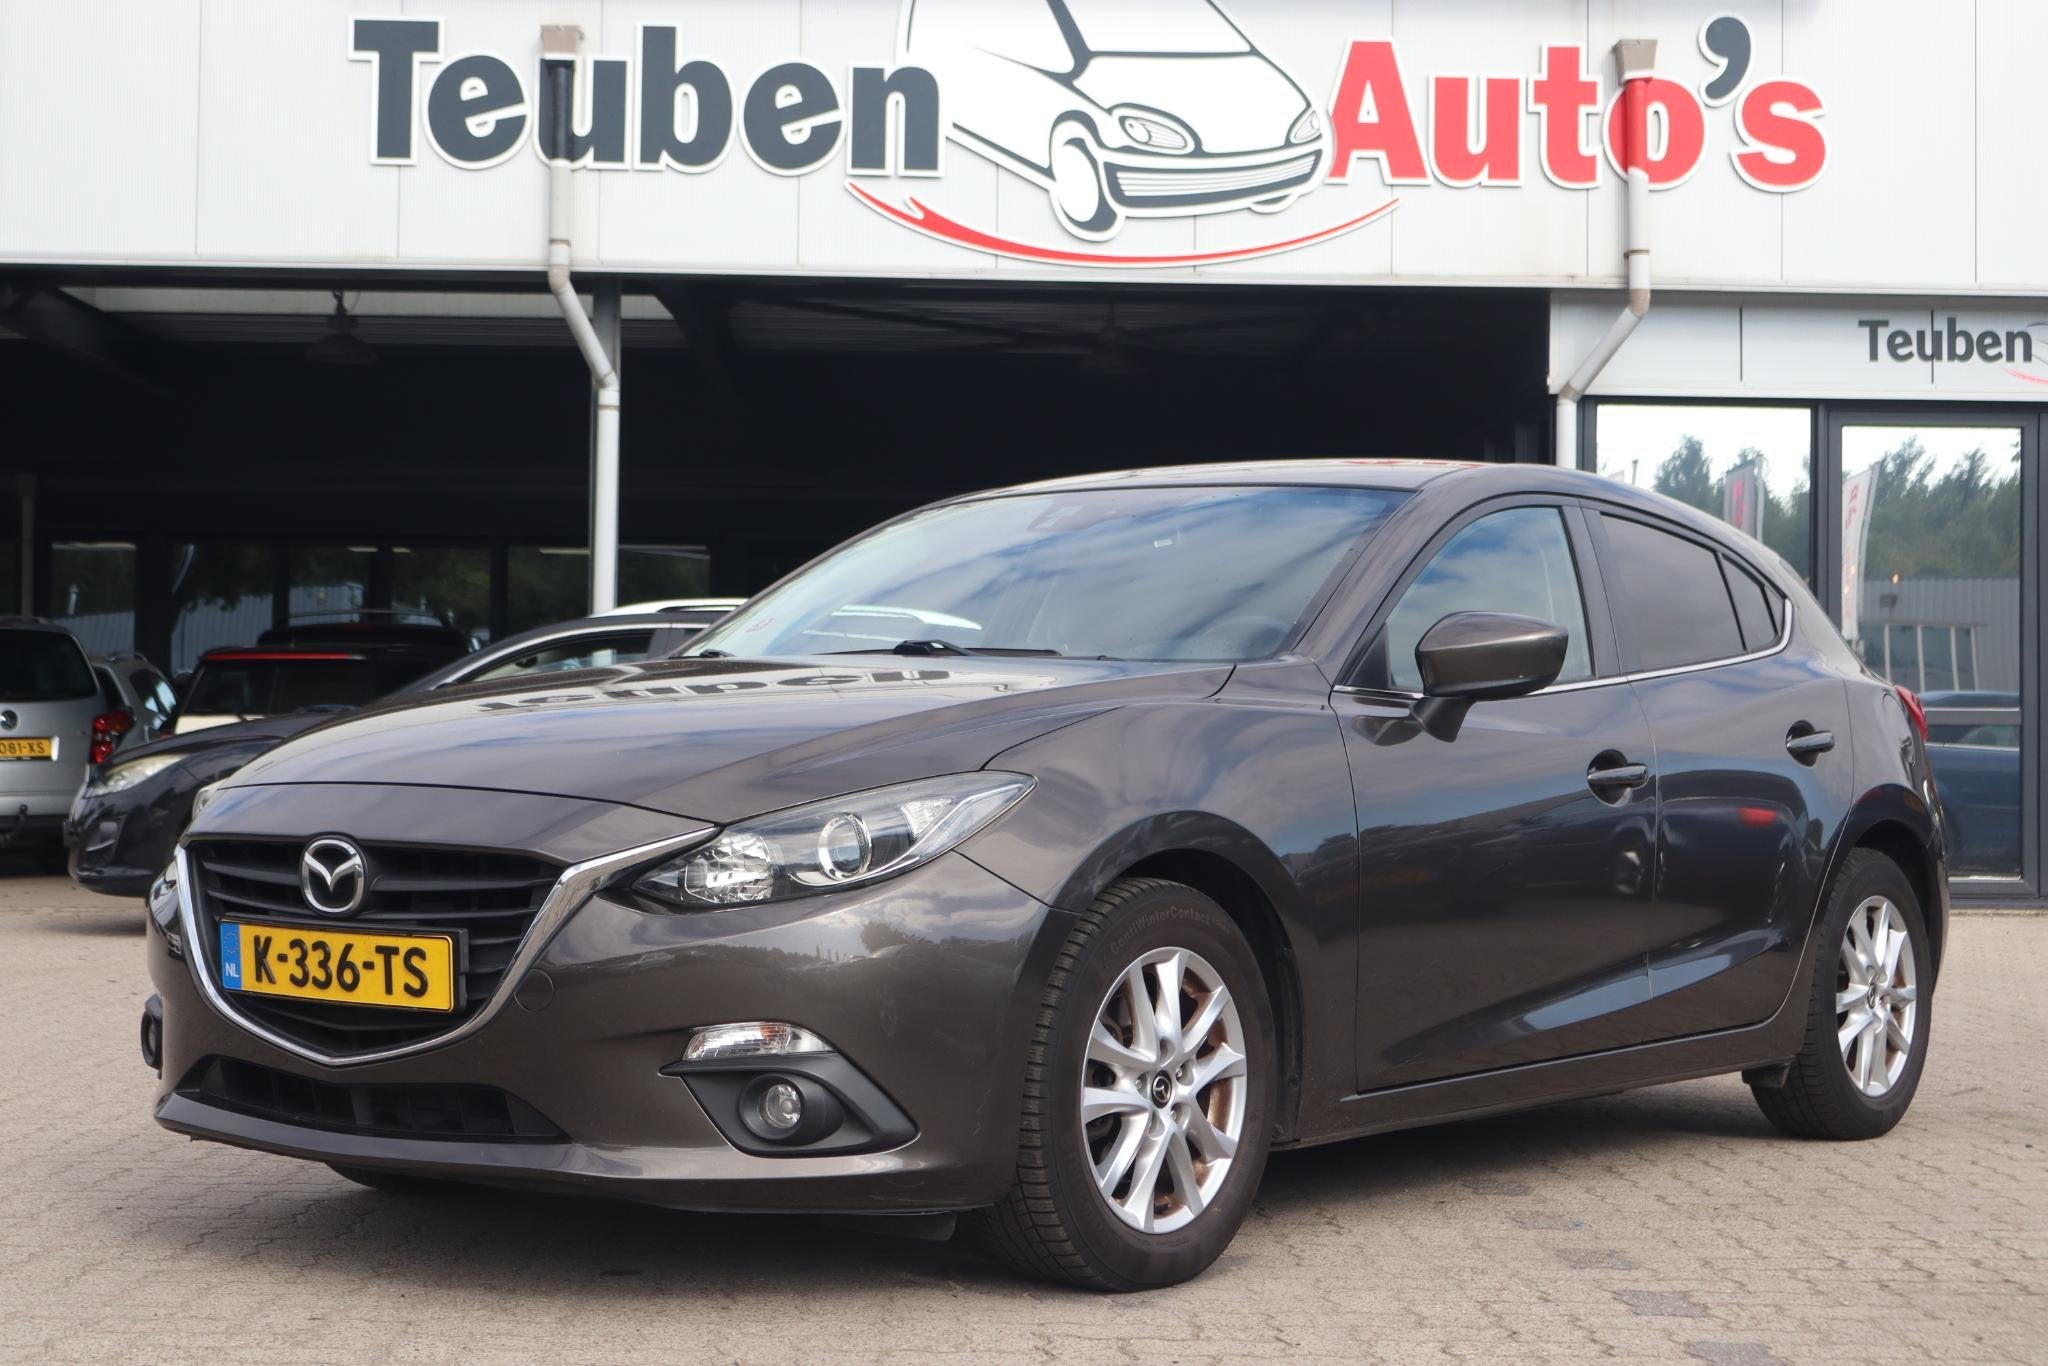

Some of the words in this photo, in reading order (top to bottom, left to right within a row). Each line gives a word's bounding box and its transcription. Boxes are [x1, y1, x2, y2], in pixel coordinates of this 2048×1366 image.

[352, 18, 941, 172] Teuben
[1326, 15, 1827, 187] Auto's
[1857, 316, 2033, 363] Teuben
[225, 962, 239, 978] NL
[253, 934, 429, 998] K-336-TS
